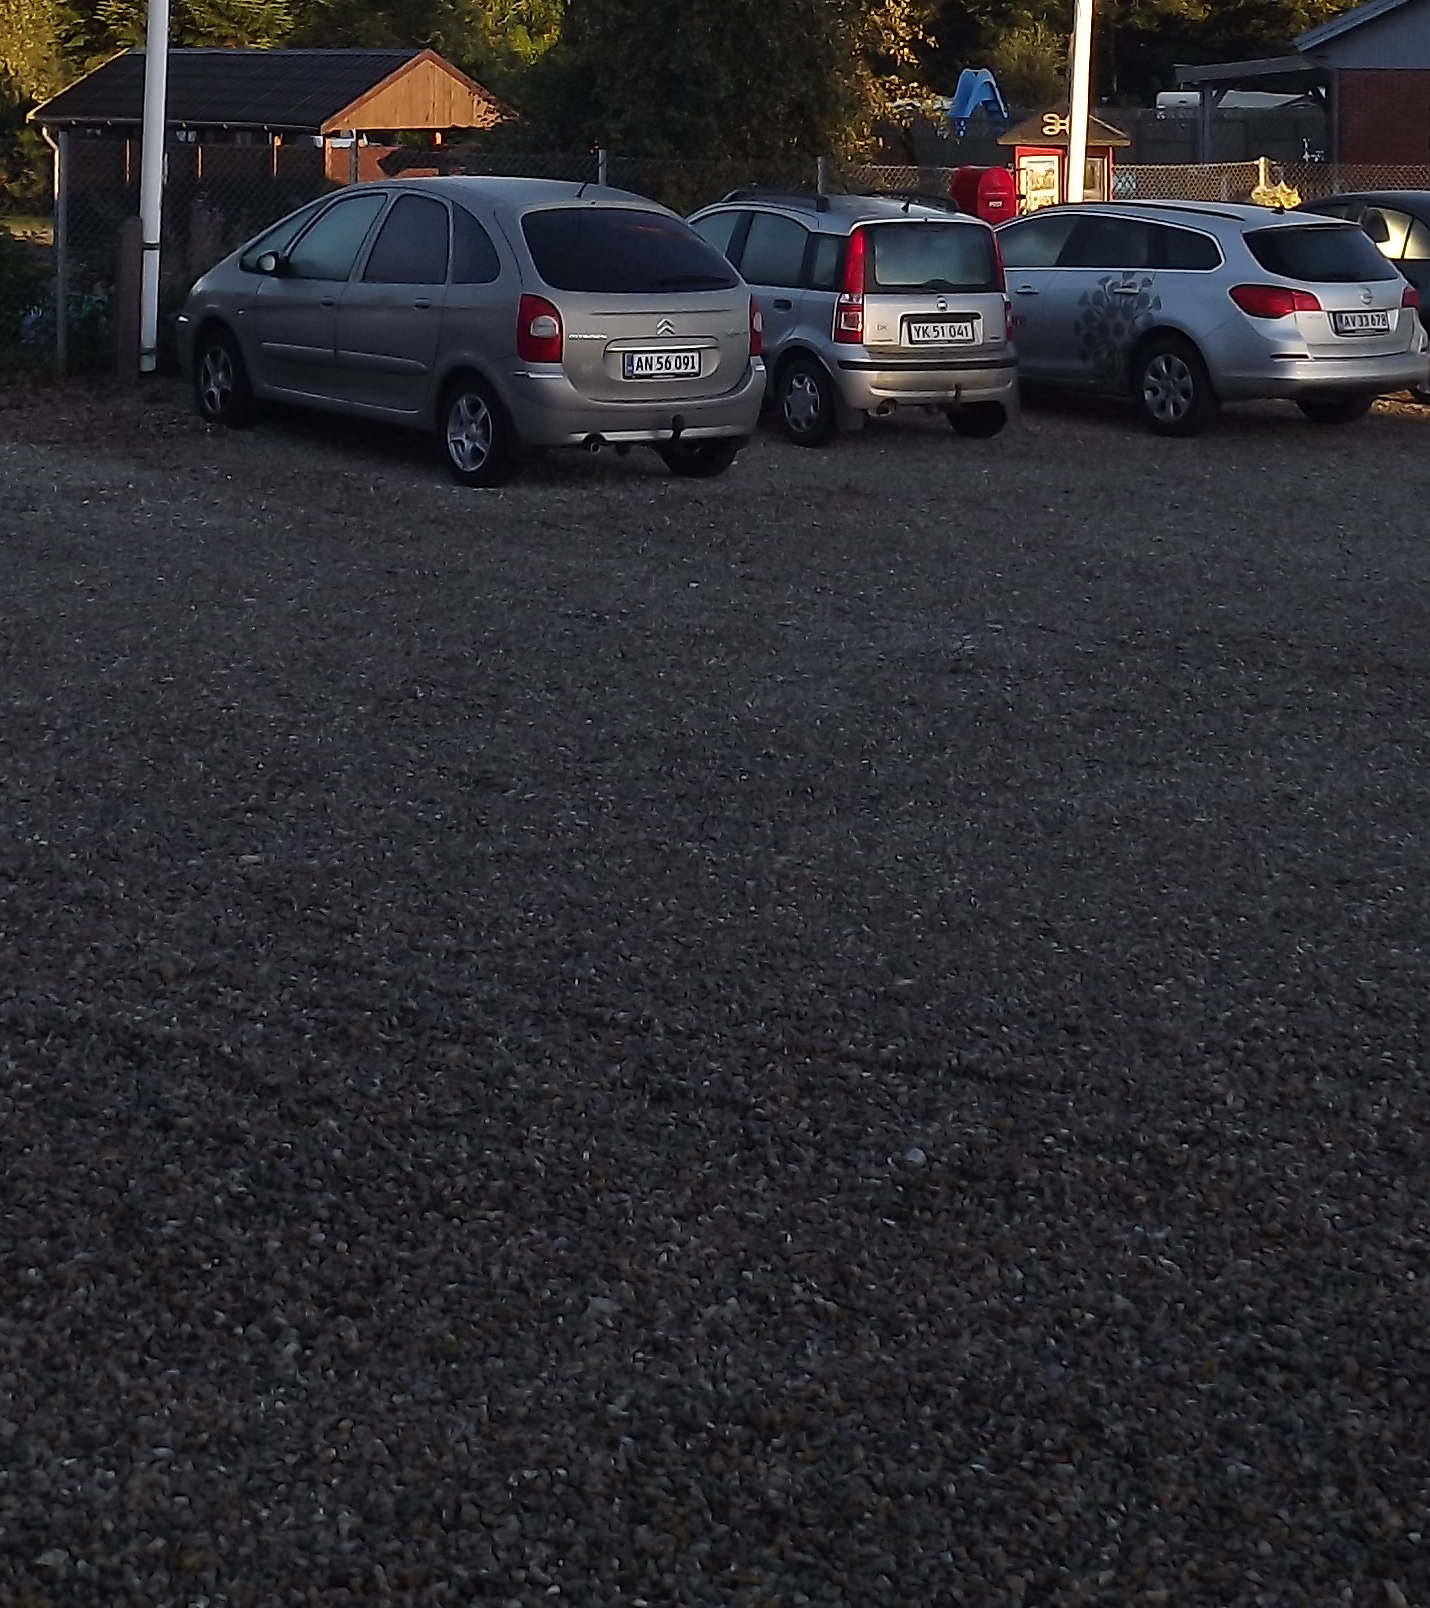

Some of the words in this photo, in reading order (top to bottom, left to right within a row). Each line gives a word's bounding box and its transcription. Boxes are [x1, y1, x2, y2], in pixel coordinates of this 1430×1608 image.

[914, 325, 931, 339] YK
[932, 325, 946, 339] 51
[948, 325, 969, 338] 041
[635, 355, 653, 371] AN
[656, 355, 671, 371] 56
[674, 354, 696, 370] 091
